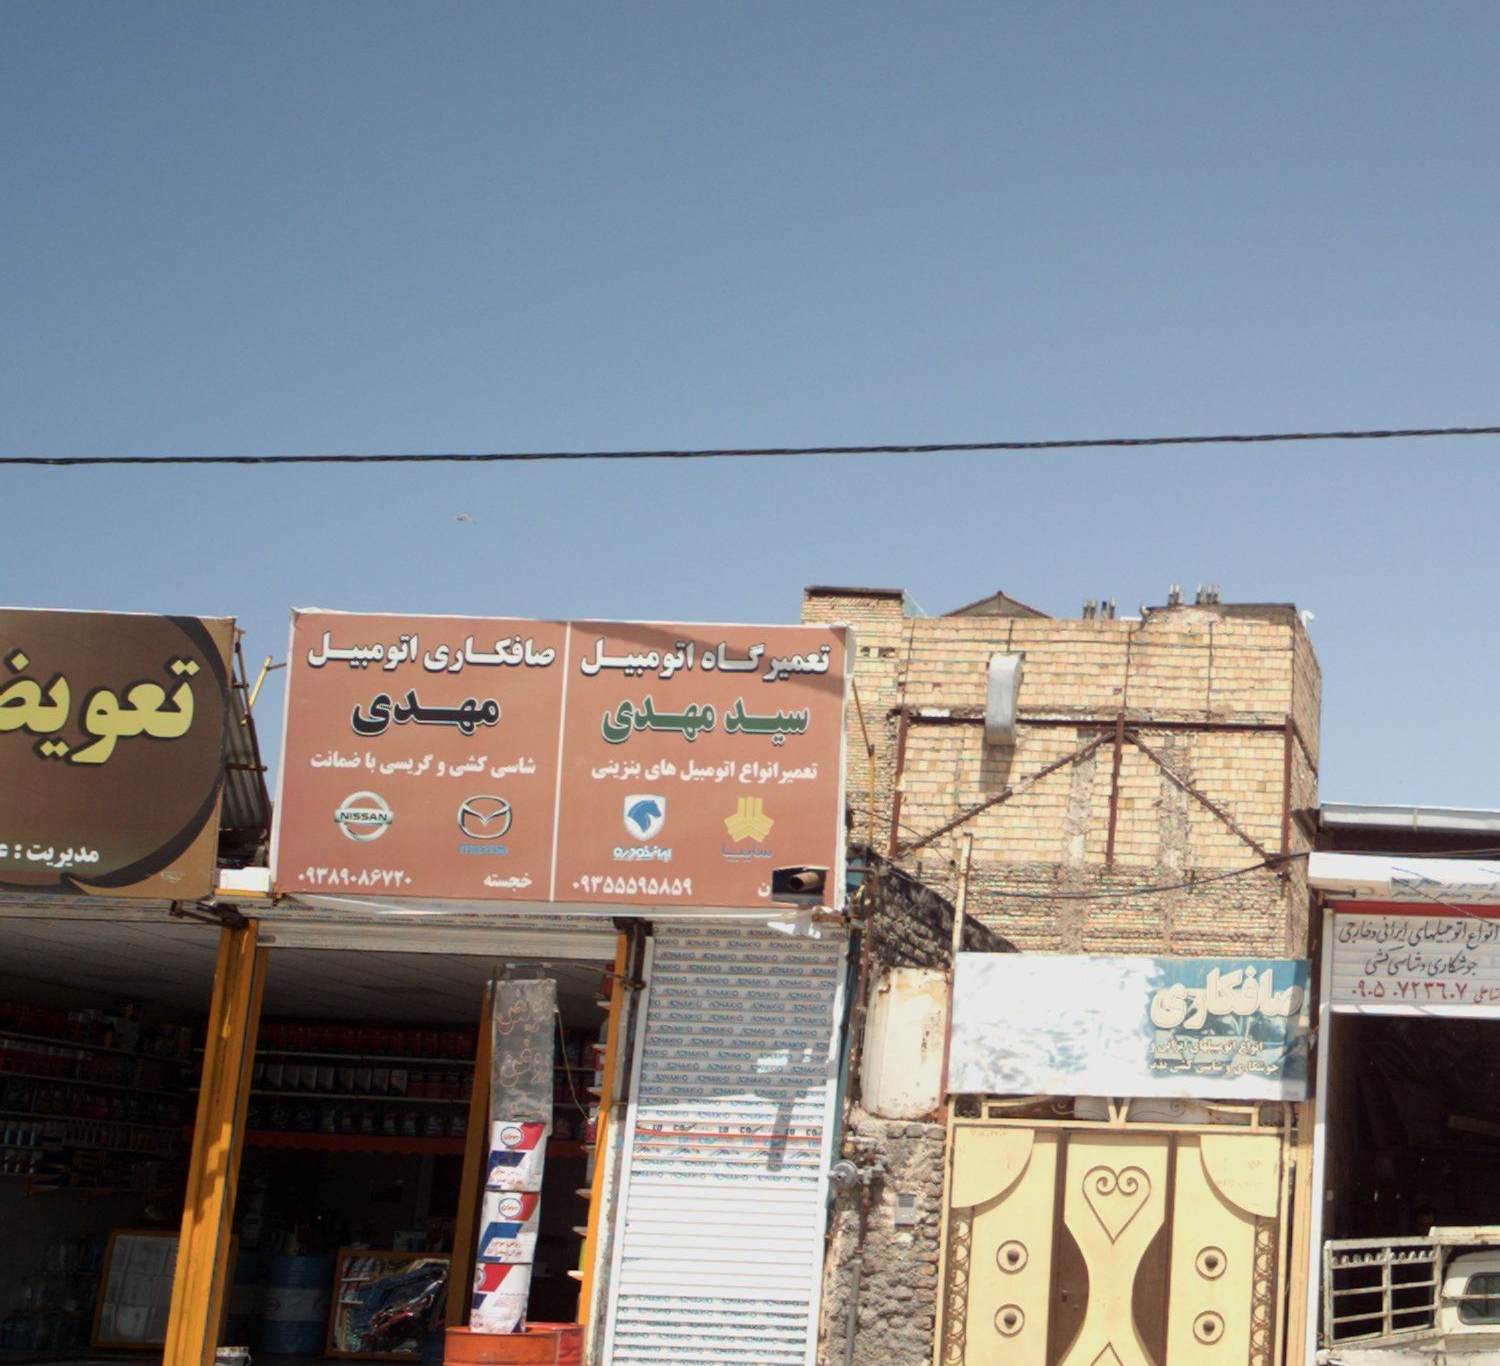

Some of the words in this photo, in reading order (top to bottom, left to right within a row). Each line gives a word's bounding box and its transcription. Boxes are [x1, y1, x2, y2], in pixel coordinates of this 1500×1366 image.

[307, 630, 418, 670] اتومبیل
[424, 635, 556, 673] صافکاری
[580, 637, 696, 679] اتومبیل
[351, 688, 501, 736] مهدی
[601, 693, 718, 745] مهدی
[724, 695, 811, 747] سید
[310, 750, 362, 769] ضمانت
[365, 752, 376, 773] با
[437, 762, 445, 775] و
[449, 755, 488, 776] کشی
[491, 756, 536, 778] شاسی
[591, 758, 641, 780] بنزینی
[644, 757, 677, 781] های
[680, 759, 736, 783] اتومبیل
[339, 811, 388, 822] NISSAN
[26, 844, 100, 869] مدیریت
[721, 843, 775, 862] سایپا
[483, 872, 533, 893] خجسته
[1466, 922, 1499, 950] انواع
[1151, 963, 1305, 1031] صافکاری
